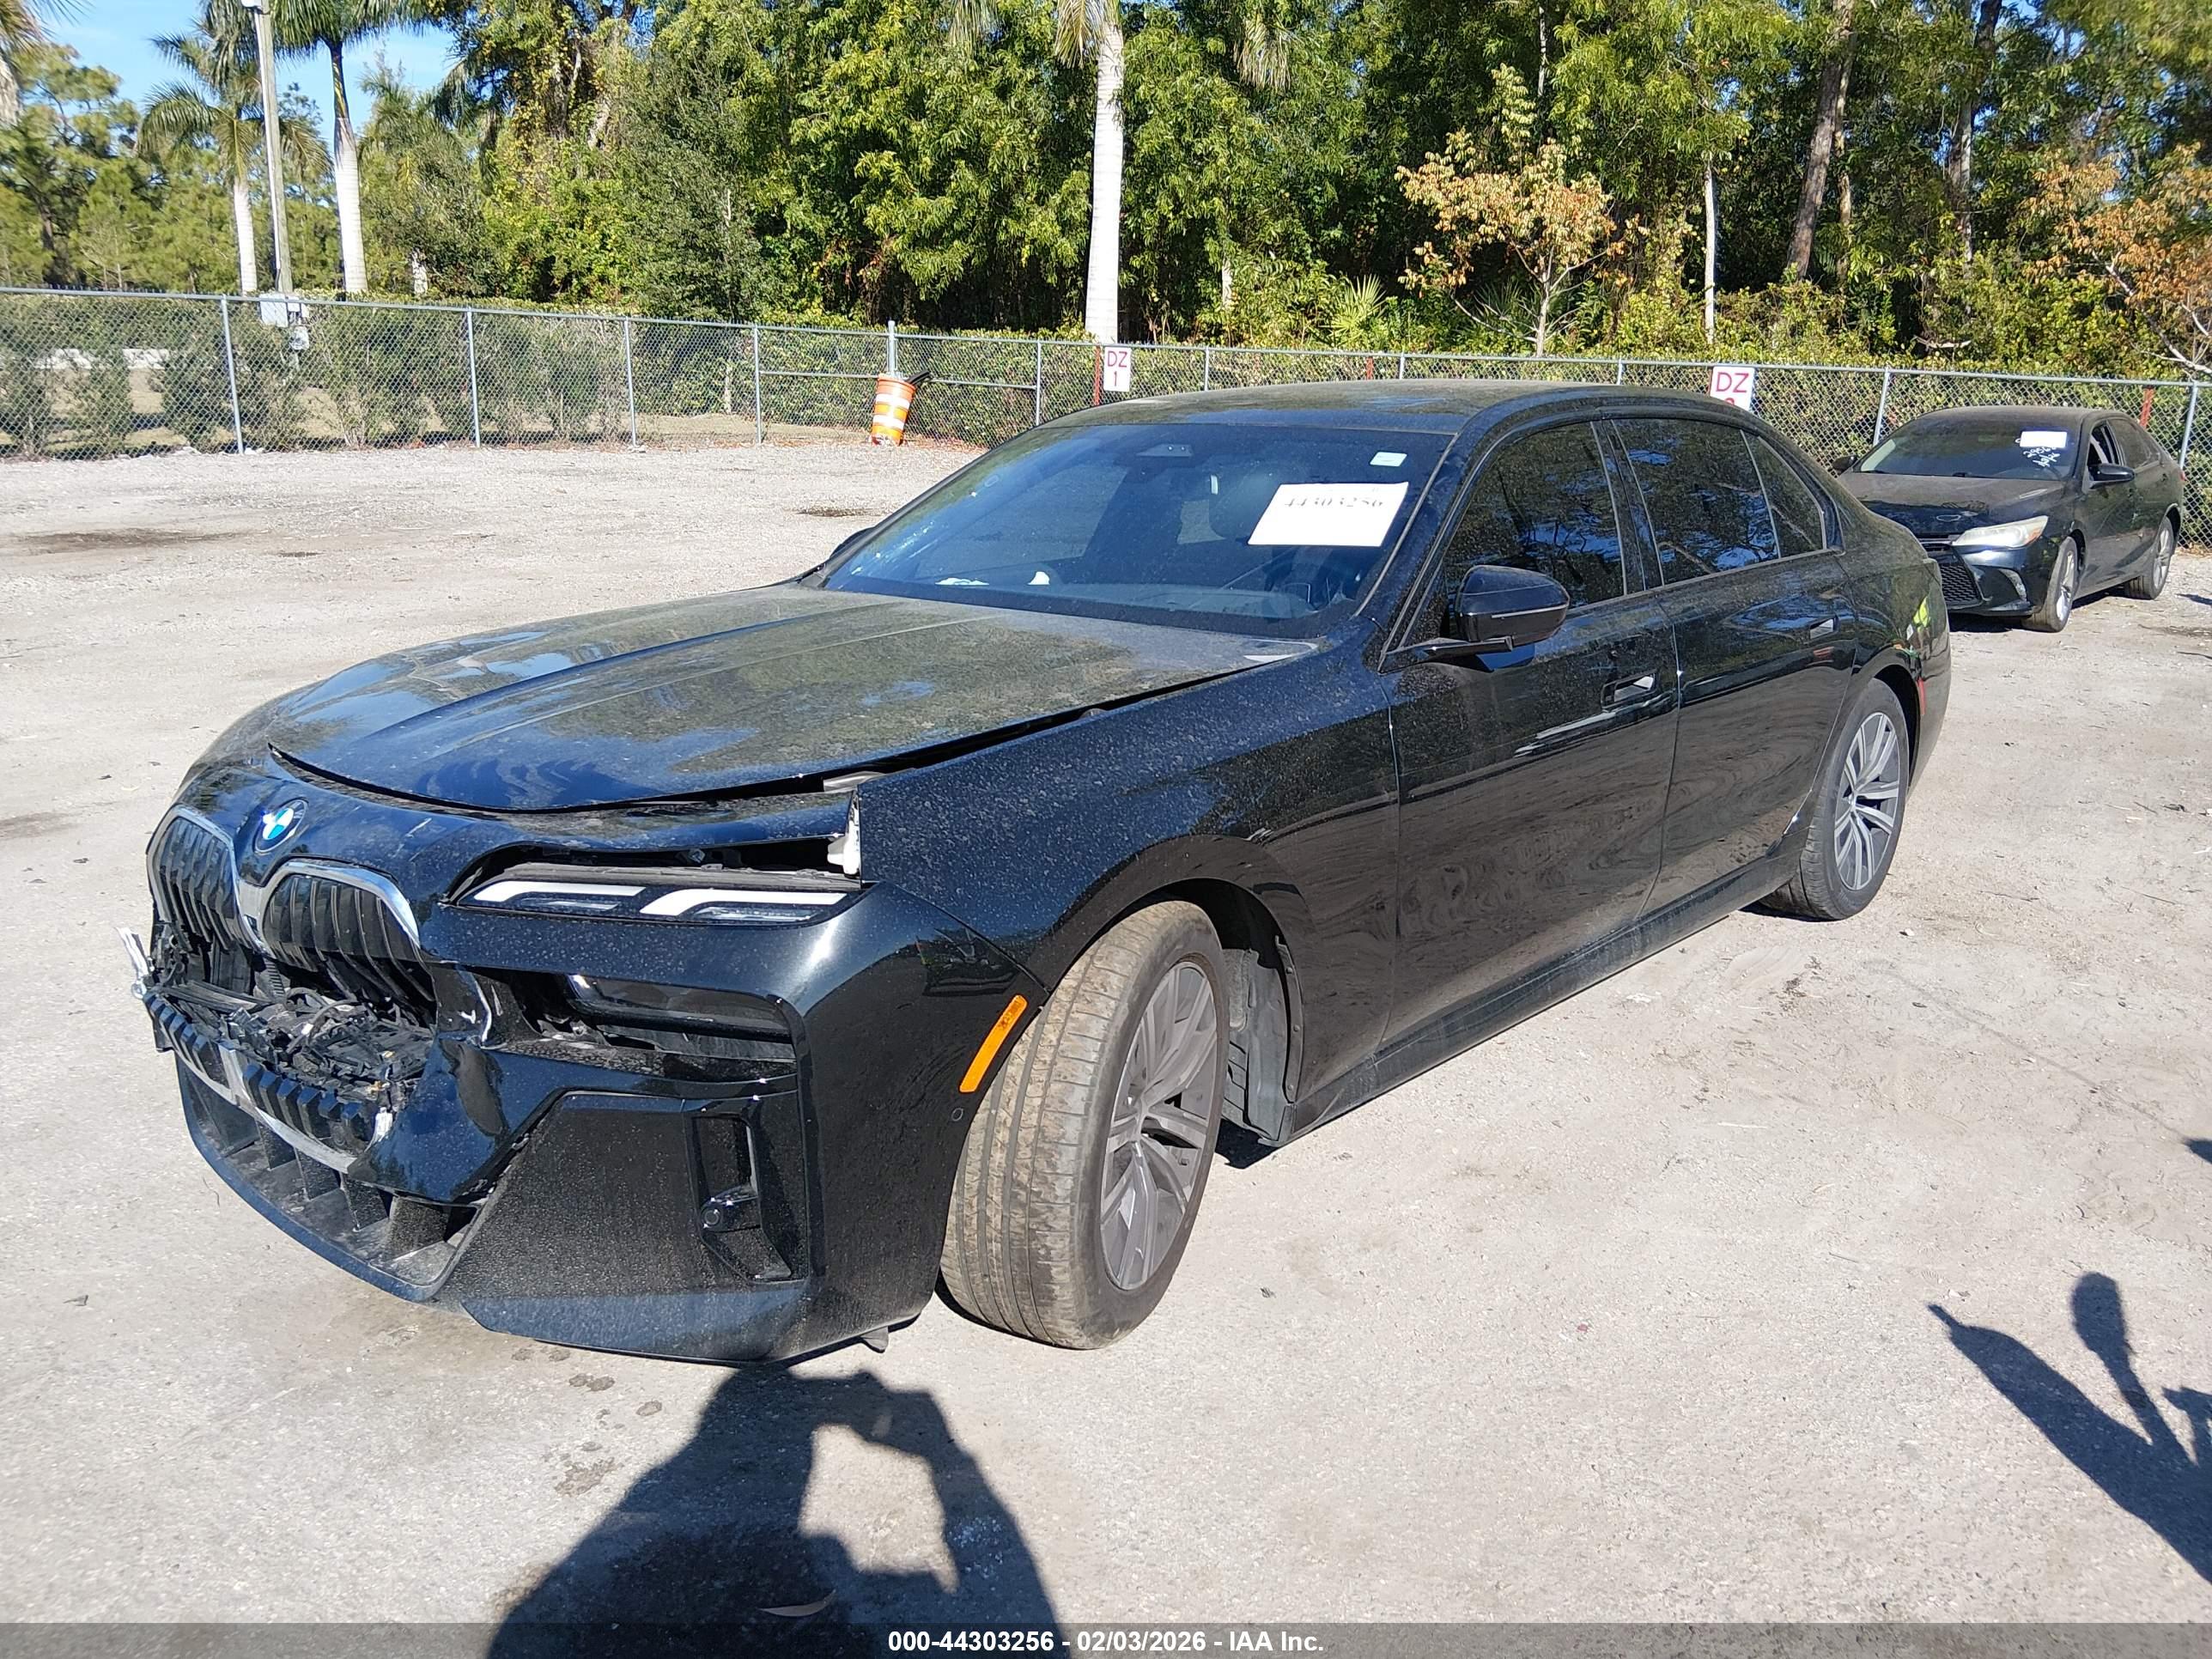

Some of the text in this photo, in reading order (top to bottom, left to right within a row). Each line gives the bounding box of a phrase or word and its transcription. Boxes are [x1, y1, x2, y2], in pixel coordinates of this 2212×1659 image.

[1107, 350, 1127, 368] DZ
[1113, 370, 1118, 386] 1
[1716, 372, 1749, 392] DZ
